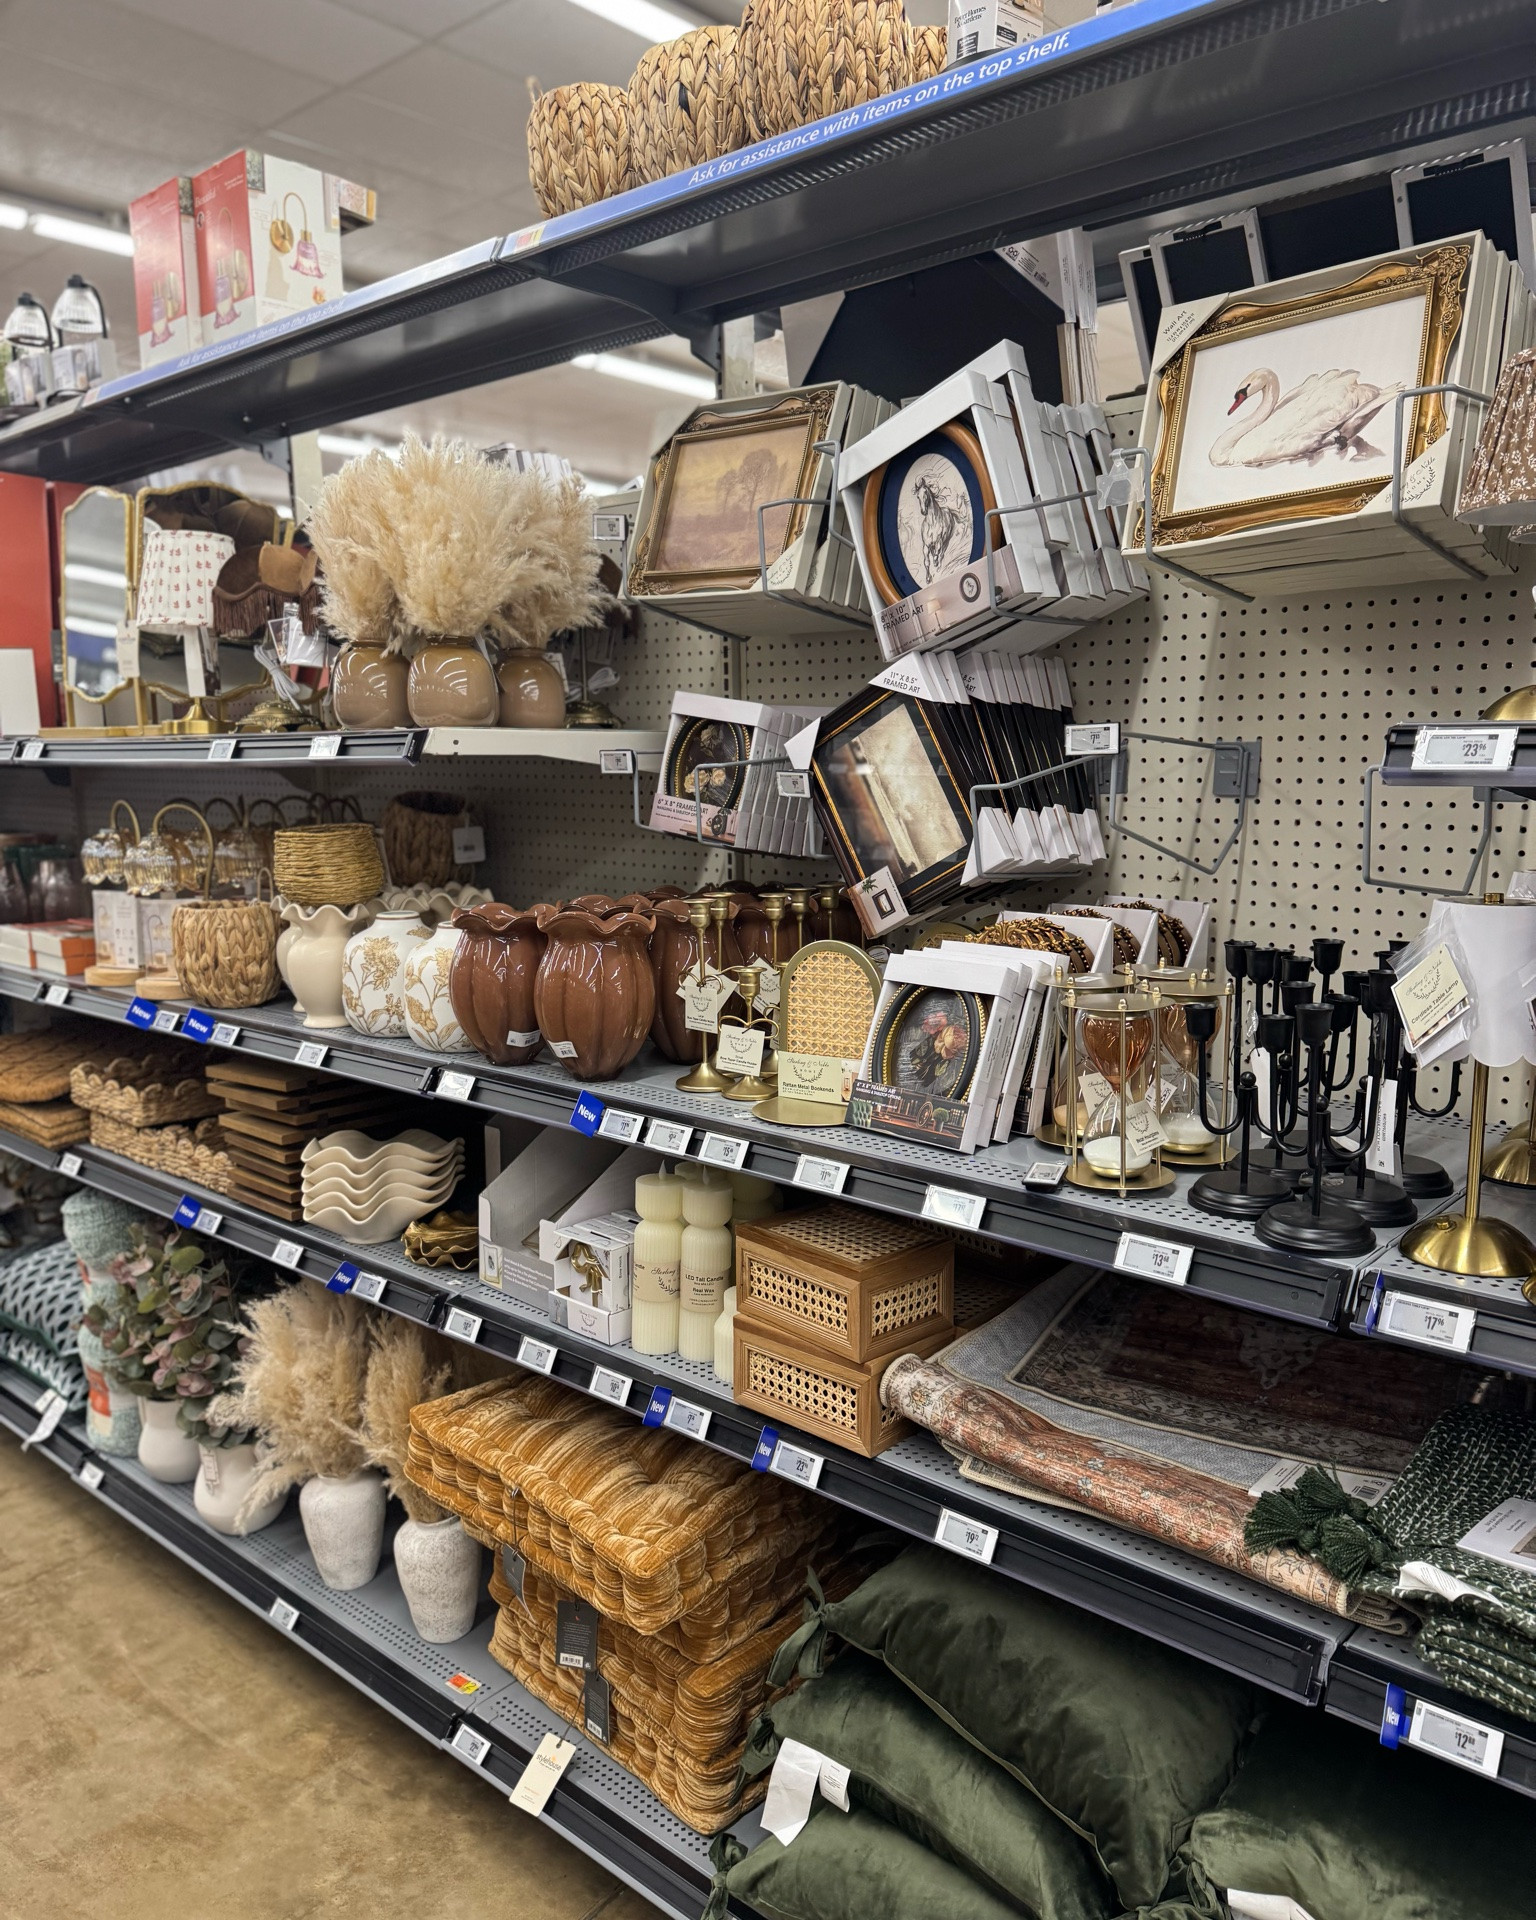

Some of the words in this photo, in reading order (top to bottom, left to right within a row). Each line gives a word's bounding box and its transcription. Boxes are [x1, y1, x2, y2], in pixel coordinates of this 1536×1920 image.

[688, 167, 715, 187] Ask
[717, 157, 741, 176] for
[741, 128, 820, 166] assistance
[823, 111, 860, 138] with
[863, 93, 912, 122] items
[914, 83, 938, 103] on
[943, 71, 976, 93] the
[978, 57, 1012, 77] top
[1015, 31, 1070, 65] shelf.
[1163, 320, 1177, 335] Wall
[1177, 310, 1187, 322] Art
[177, 357, 192, 369] Ask
[192, 353, 201, 365] for
[201, 340, 239, 363] assistance
[240, 333, 257, 348] with
[257, 325, 279, 341] items
[278, 321, 291, 333] on
[290, 314, 306, 328] the
[305, 309, 320, 324] top
[320, 301, 345, 318] shelf.
[881, 611, 889, 624] 8"
[895, 604, 907, 615] 10"
[883, 611, 911, 632] FRAMED
[911, 604, 925, 618] ART
[883, 677, 909, 691] FRAMED
[909, 685, 921, 694] ART
[890, 671, 900, 679] 11"
[905, 676, 919, 685] 8.5"
[676, 802, 698, 812] FRAMED
[1411, 1004, 1433, 1025] Cordless
[1432, 992, 1446, 1006] Table
[1445, 979, 1459, 995] Lamp
[131, 1005, 151, 1021] New
[188, 1018, 208, 1034] New
[786, 1056, 806, 1067] Sterling
[783, 1081, 797, 1089] Rattan
[810, 1085, 835, 1093] Bookends
[578, 1104, 597, 1123] New
[179, 1203, 196, 1220] New
[334, 1270, 352, 1286] New
[650, 1266, 676, 1277] Sterling
[685, 1273, 695, 1281] LED
[706, 1275, 724, 1283] Candle
[650, 1400, 666, 1414] New
[758, 1441, 772, 1457] New
[1385, 1705, 1401, 1727] New
[536, 1753, 562, 1772] stylehouse
